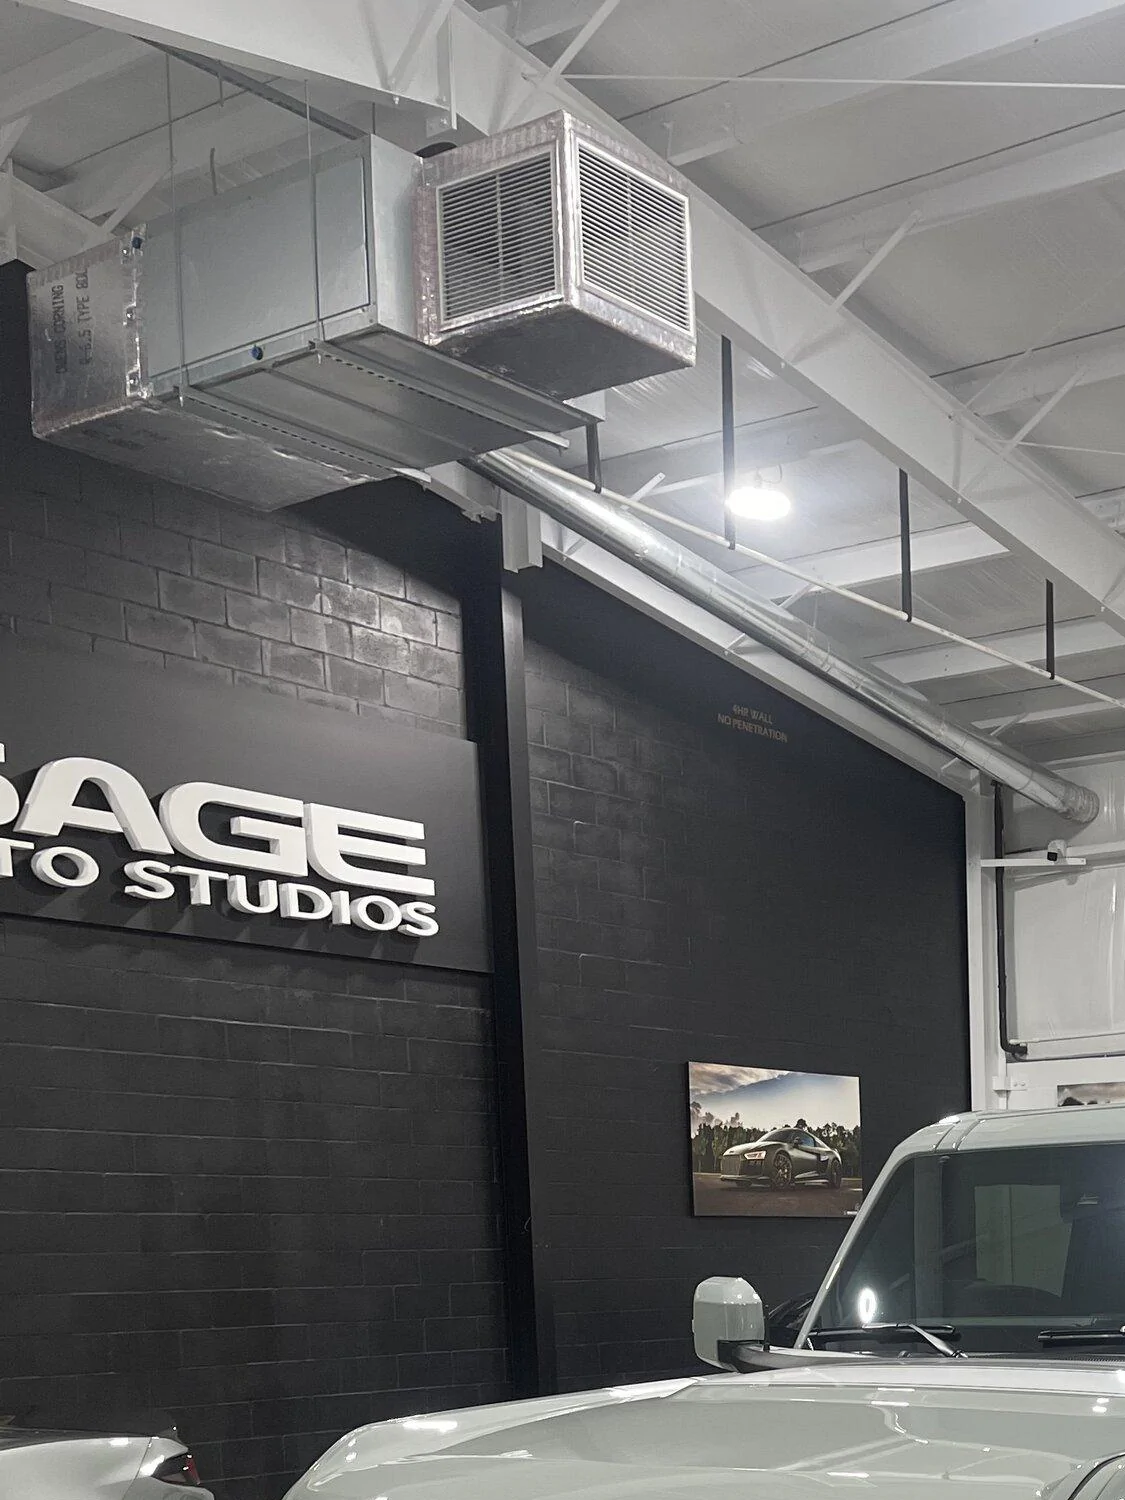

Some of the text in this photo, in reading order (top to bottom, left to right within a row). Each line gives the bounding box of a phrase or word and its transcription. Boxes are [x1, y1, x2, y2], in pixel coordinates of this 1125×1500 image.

[52, 284, 66, 333] CORNING
[76, 295, 92, 323] TYPE
[718, 712, 788, 743] NO PENETRATION
[750, 708, 773, 725] WALL
[0, 743, 436, 897] AGE
[123, 858, 439, 938] STUDIOS
